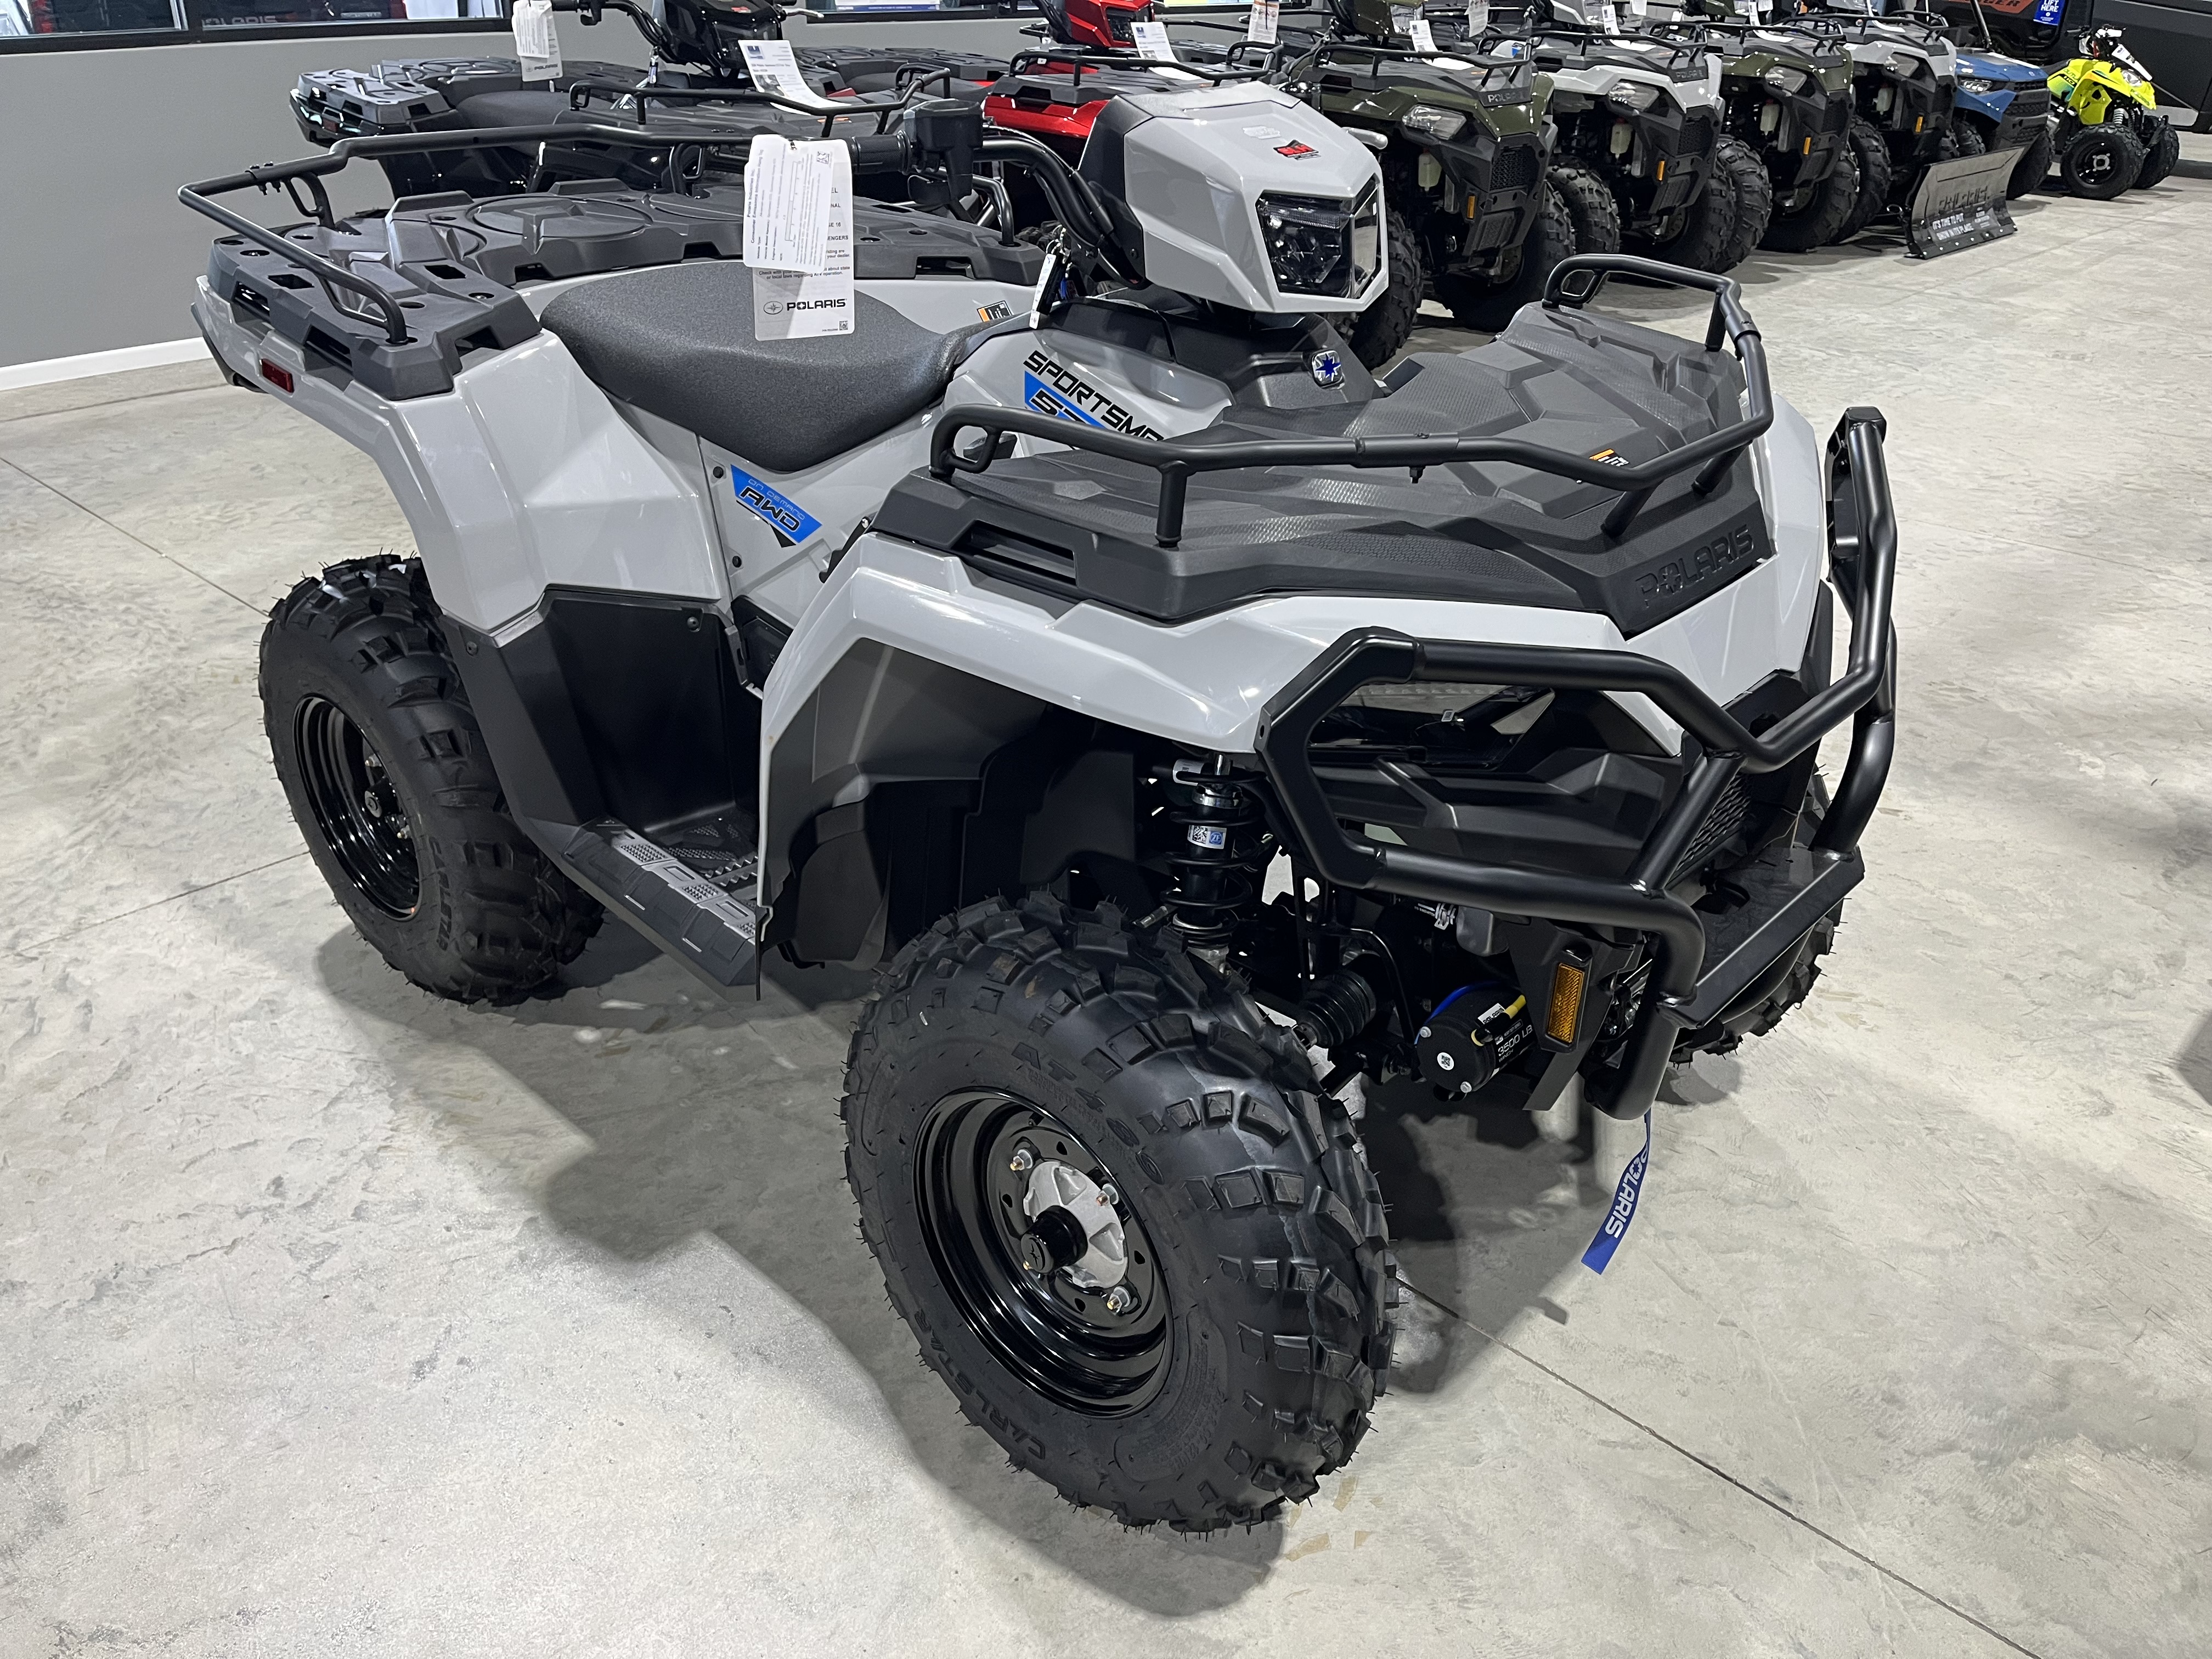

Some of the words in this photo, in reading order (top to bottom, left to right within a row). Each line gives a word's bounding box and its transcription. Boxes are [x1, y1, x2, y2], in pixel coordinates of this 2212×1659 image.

[787, 298, 846, 311] POLARIS
[739, 486, 800, 532] AWD
[766, 491, 805, 520] DEMAND
[1634, 523, 1754, 609] POLARIS
[1483, 1007, 1504, 1024] POLARIS
[1498, 1034, 1520, 1057] 3500
[914, 1308, 1046, 1460] CARLSTAR
